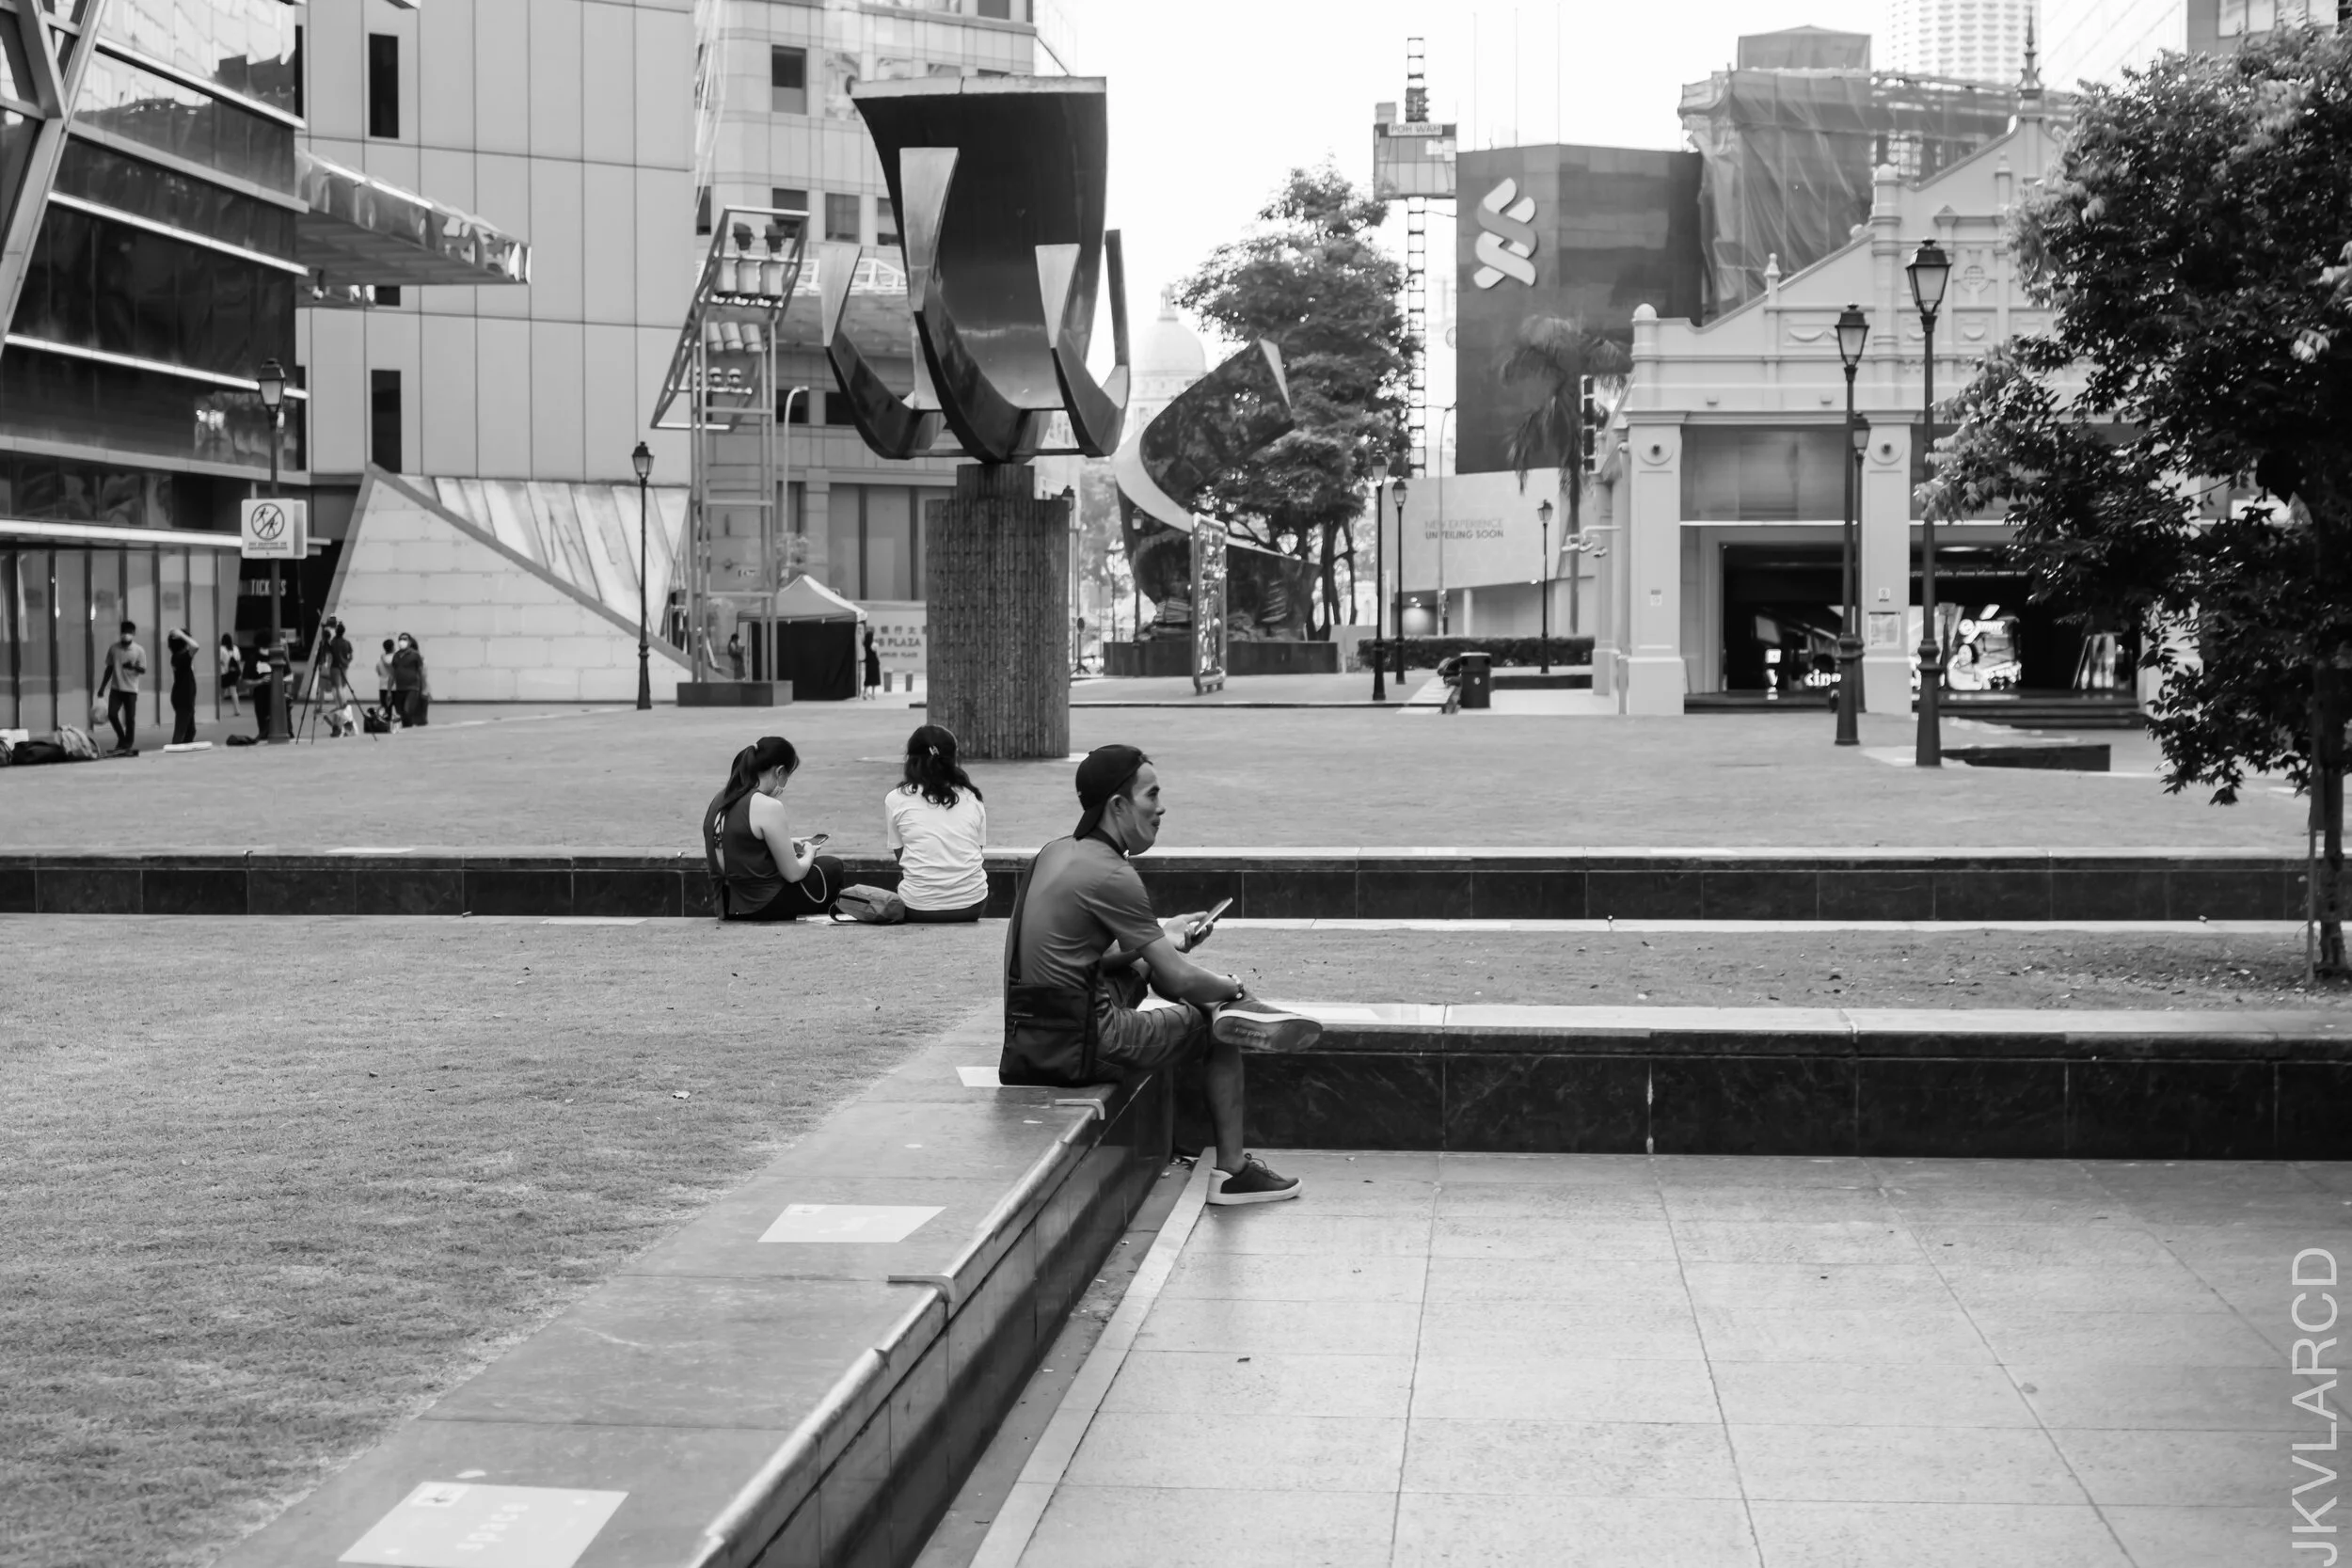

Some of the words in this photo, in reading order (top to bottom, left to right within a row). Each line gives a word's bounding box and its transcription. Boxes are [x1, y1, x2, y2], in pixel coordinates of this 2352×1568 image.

[1476, 529, 1503, 538] SOON
[250, 579, 287, 596] TICKS
[887, 638, 921, 647] PLAZA
